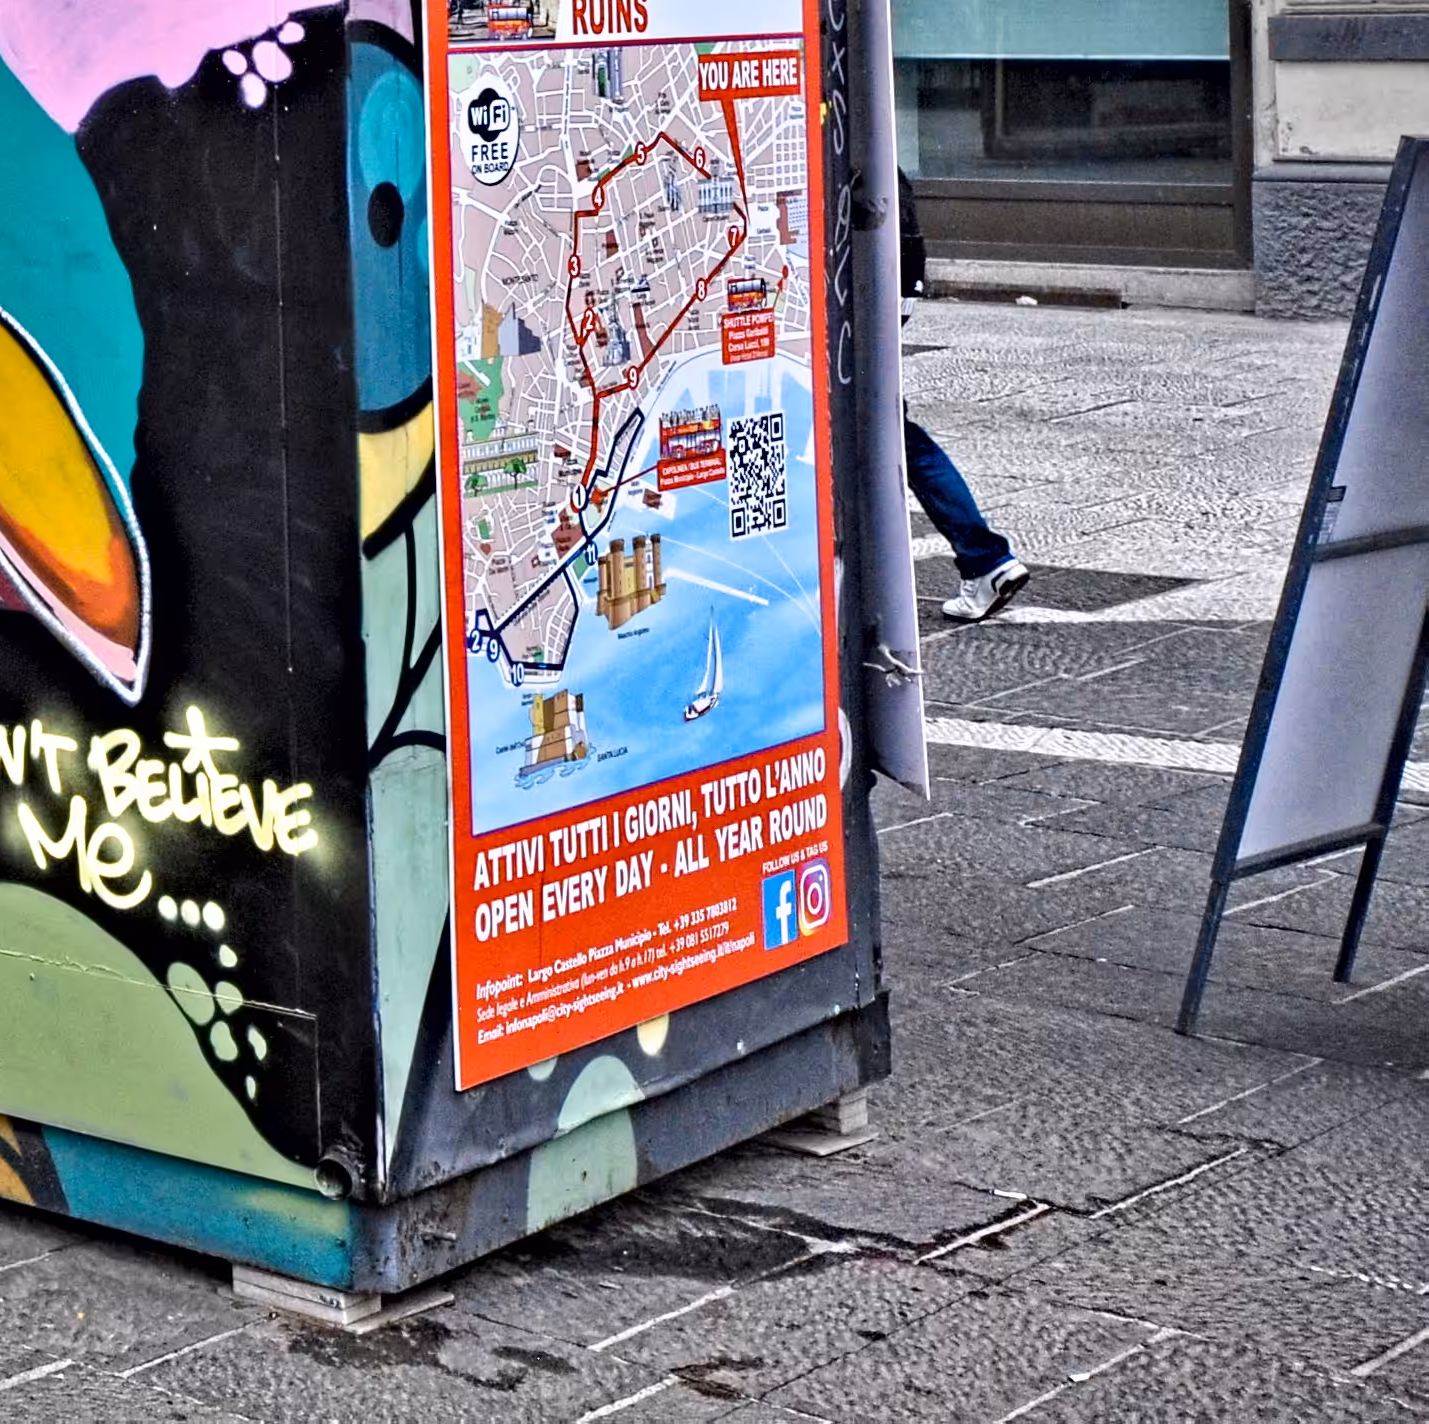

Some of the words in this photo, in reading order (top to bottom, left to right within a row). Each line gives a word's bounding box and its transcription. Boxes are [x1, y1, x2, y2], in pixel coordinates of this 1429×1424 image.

[699, 61, 728, 91] YOU
[732, 61, 759, 89] ARE
[761, 58, 799, 88] HERE
[471, 142, 509, 162] FREE
[484, 162, 510, 174] BOARD
[474, 835, 544, 891] ATTIVI
[549, 815, 608, 867] TUTTI
[613, 812, 620, 848] I
[625, 789, 698, 843] GIORNI,
[701, 768, 761, 818] TUTTO
[765, 747, 826, 799] L'ANNO
[475, 889, 534, 942] OPEN
[543, 865, 608, 922] EVERY
[615, 850, 653, 898] DAY
[675, 834, 709, 878] ALL
[715, 816, 763, 862] YEAR
[769, 794, 827, 845] ROUND
[762, 855, 790, 874] FOLLOW
[791, 851, 799, 864] US
[819, 841, 828, 853] US
[477, 974, 523, 1000] Infopoint:
[528, 966, 553, 982] Largo
[554, 953, 587, 973] Castello
[588, 944, 614, 962] Piazza
[674, 914, 689, 930] +39
[478, 1024, 504, 1044] Email:
